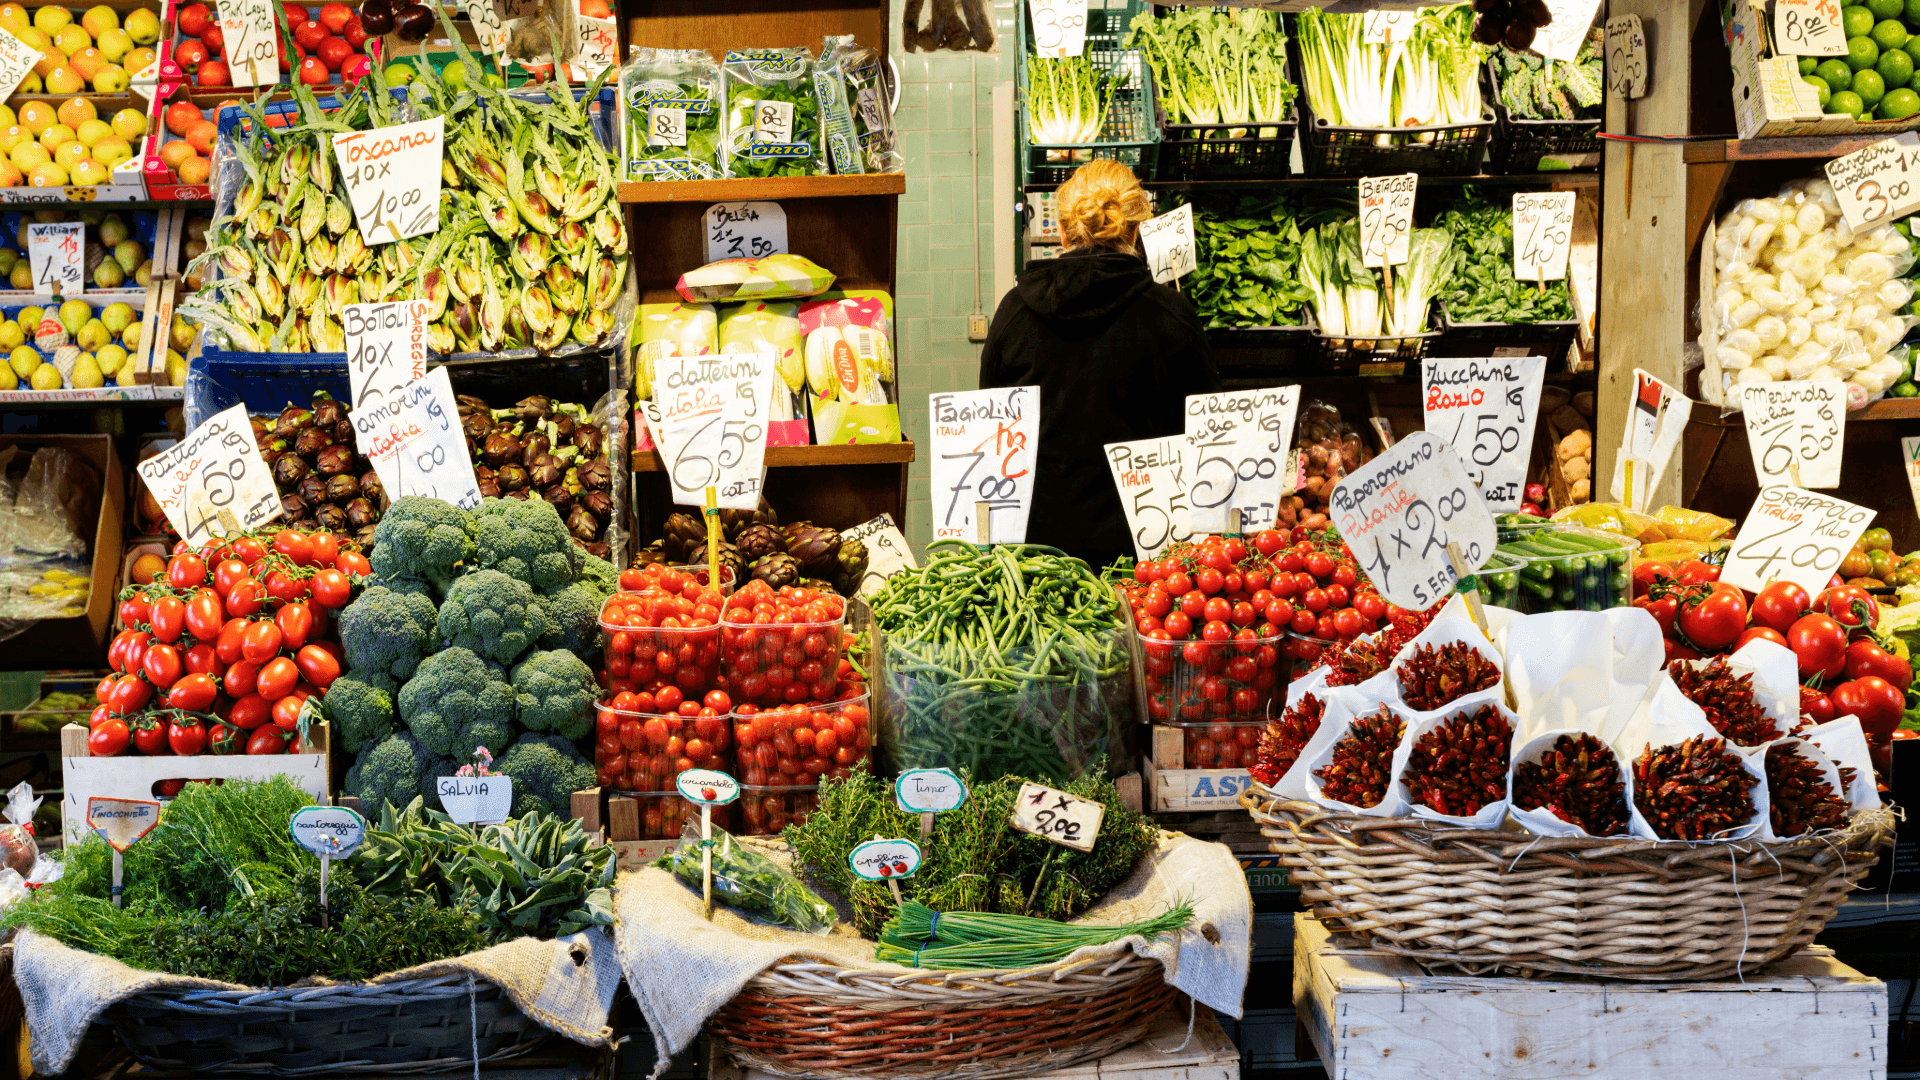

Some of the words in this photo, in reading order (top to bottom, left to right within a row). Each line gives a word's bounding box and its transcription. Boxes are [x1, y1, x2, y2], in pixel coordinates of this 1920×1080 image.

[652, 101, 708, 111] ORTO
[335, 130, 437, 164] Toscana
[752, 145, 809, 155] ORTO
[1390, 194, 1410, 211] KILO
[1516, 195, 1568, 213] SPINACINI
[409, 302, 427, 380] SARDEGNA
[1426, 358, 1520, 391] Zucchine
[142, 419, 229, 479] Vittoria
[1108, 441, 1182, 471] PISELLI
[1331, 441, 1433, 521] Peperoncino
[1757, 500, 1802, 524] ITALIA
[1810, 517, 1851, 539] KILO
[1761, 484, 1867, 524] GRAPPOLO
[439, 780, 490, 798] SALVIA
